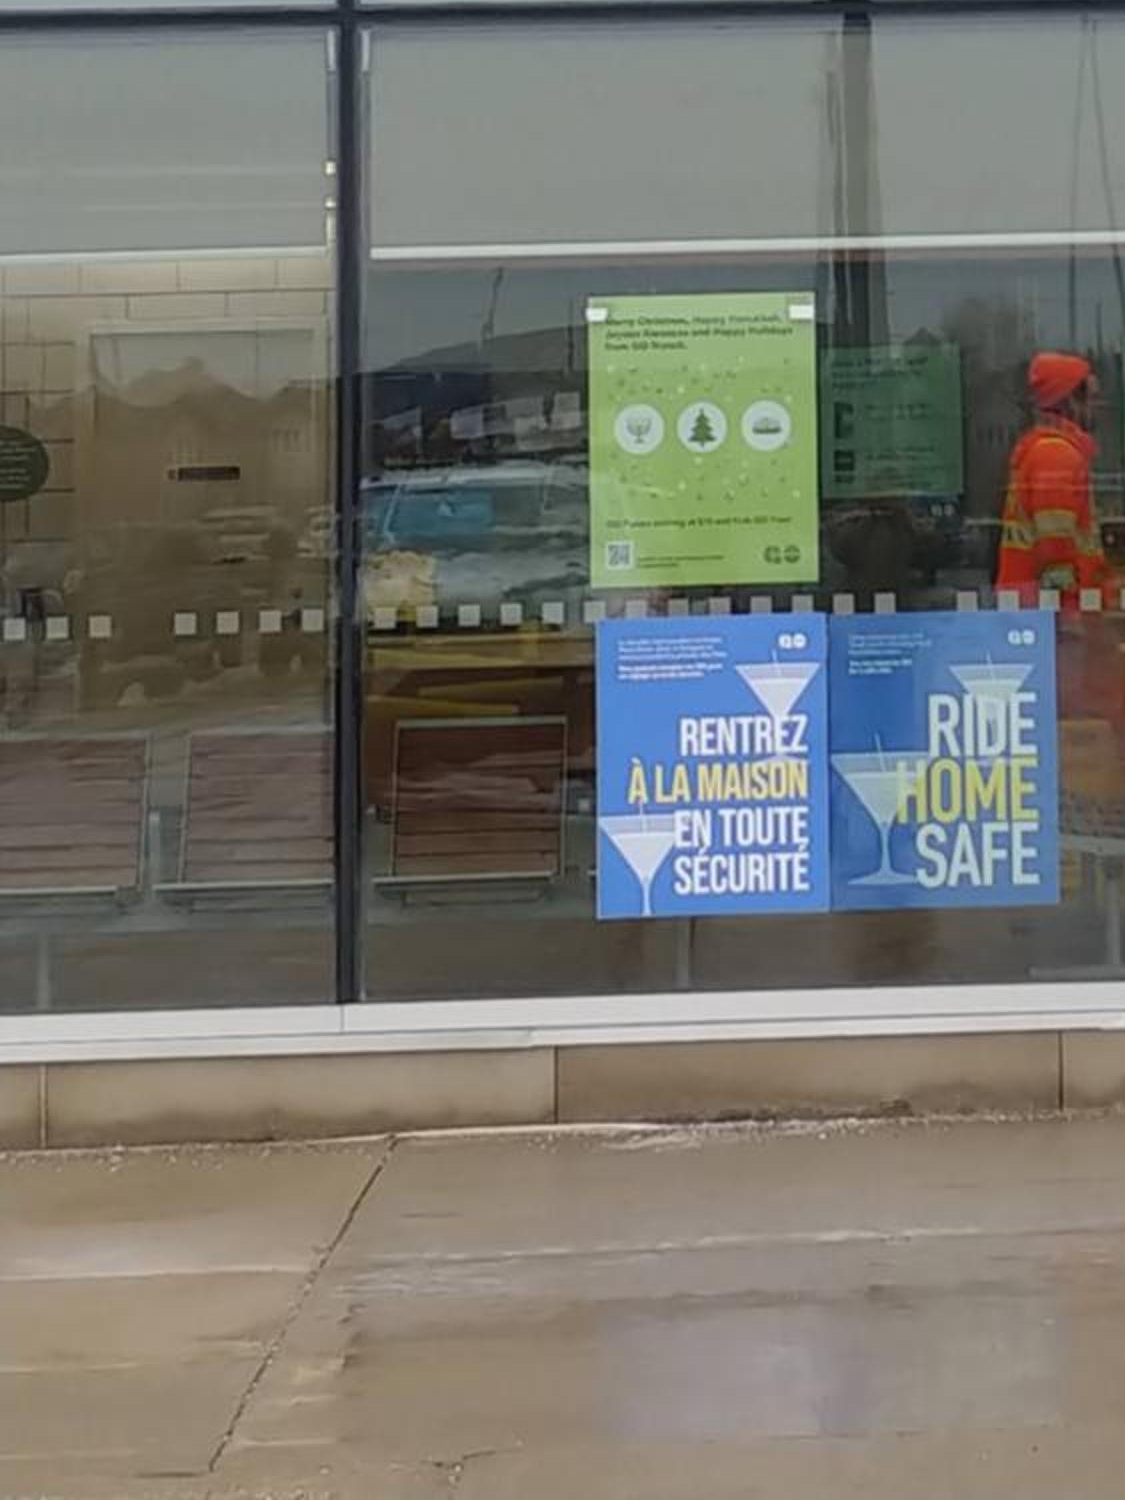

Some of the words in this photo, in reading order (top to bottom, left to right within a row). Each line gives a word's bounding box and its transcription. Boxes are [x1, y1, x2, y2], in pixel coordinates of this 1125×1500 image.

[680, 714, 808, 756] RENTREZ
[928, 692, 1037, 757] RIDE
[628, 756, 648, 804] À
[655, 764, 691, 804] LA
[697, 759, 808, 802] MAISON
[896, 757, 1039, 824] HOME
[674, 809, 711, 848] EN
[718, 806, 809, 846] TOUTE
[674, 843, 810, 894] SÉCURITÉ
[916, 821, 1040, 888] SAFE
